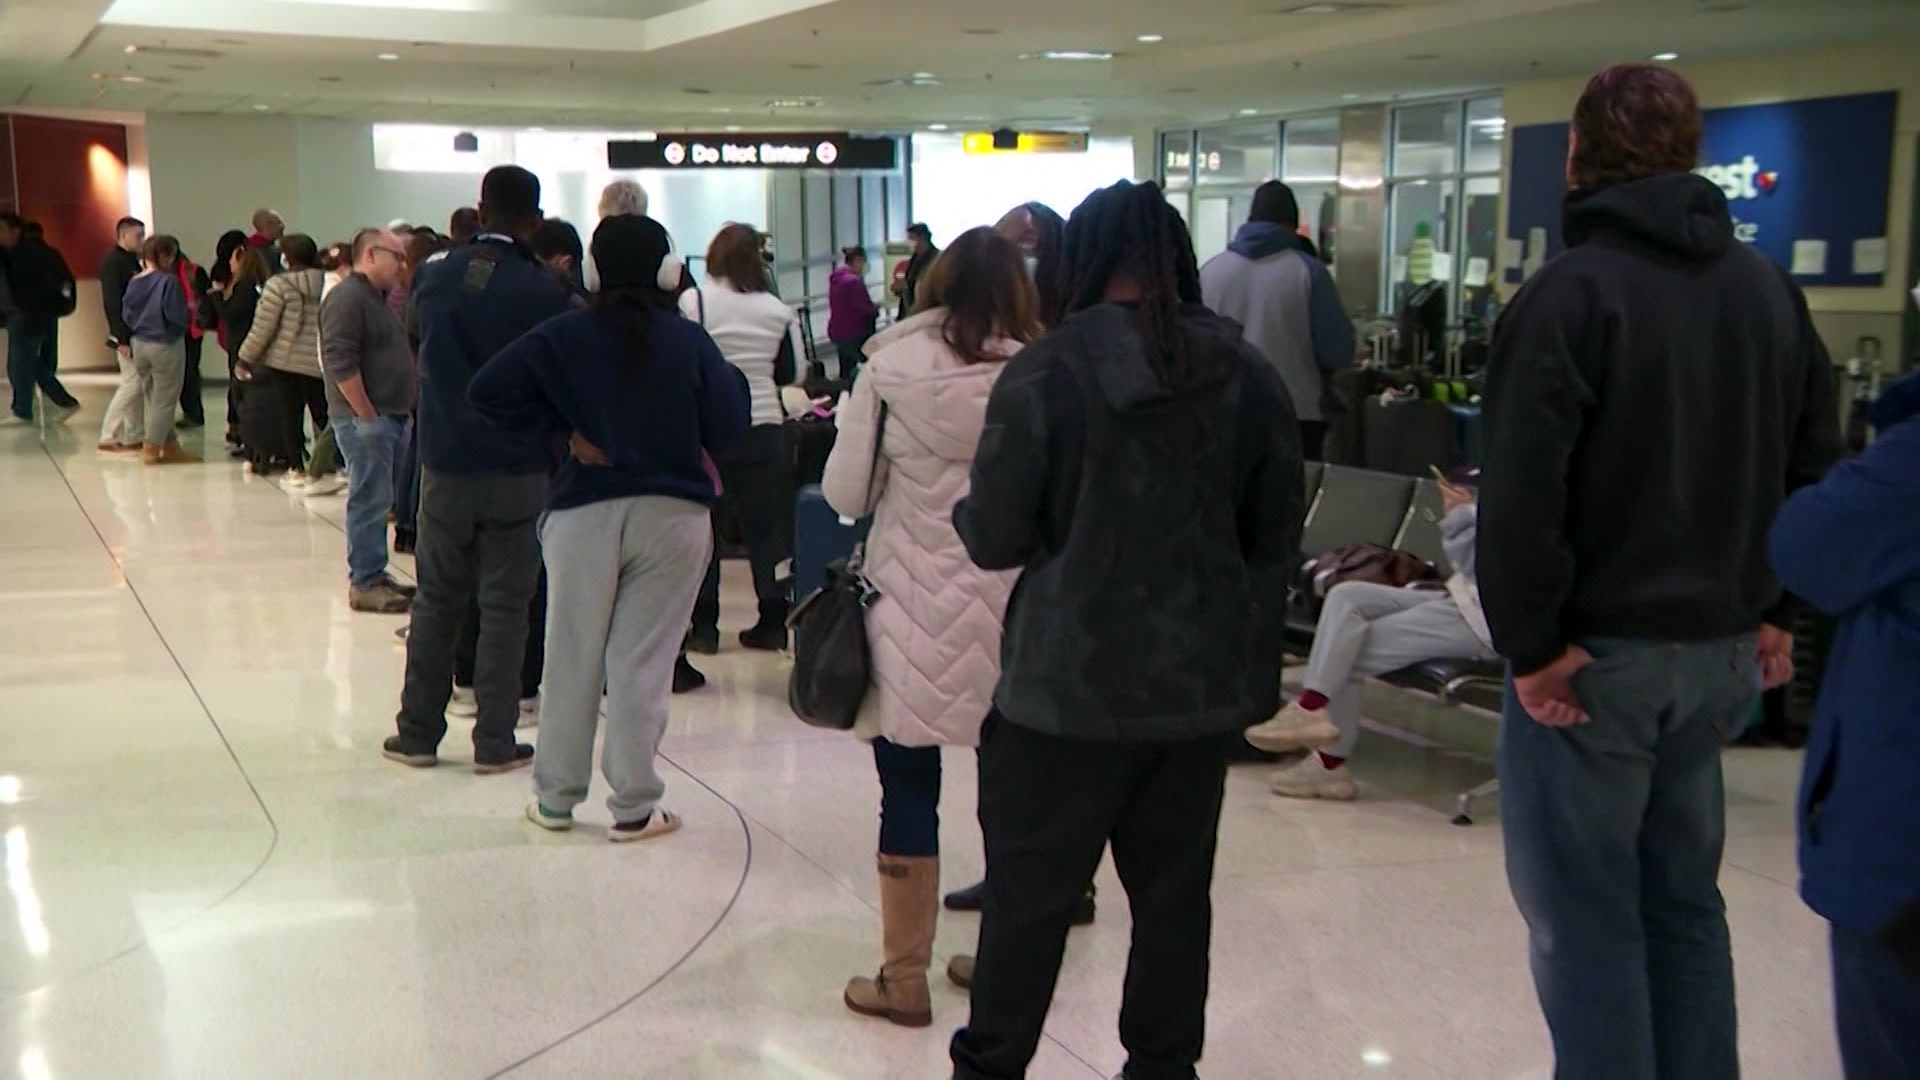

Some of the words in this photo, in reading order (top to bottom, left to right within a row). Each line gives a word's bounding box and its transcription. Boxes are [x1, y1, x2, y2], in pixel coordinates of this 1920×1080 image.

[692, 143, 719, 163] Do
[722, 143, 757, 163] Not
[760, 143, 810, 163] Enter
